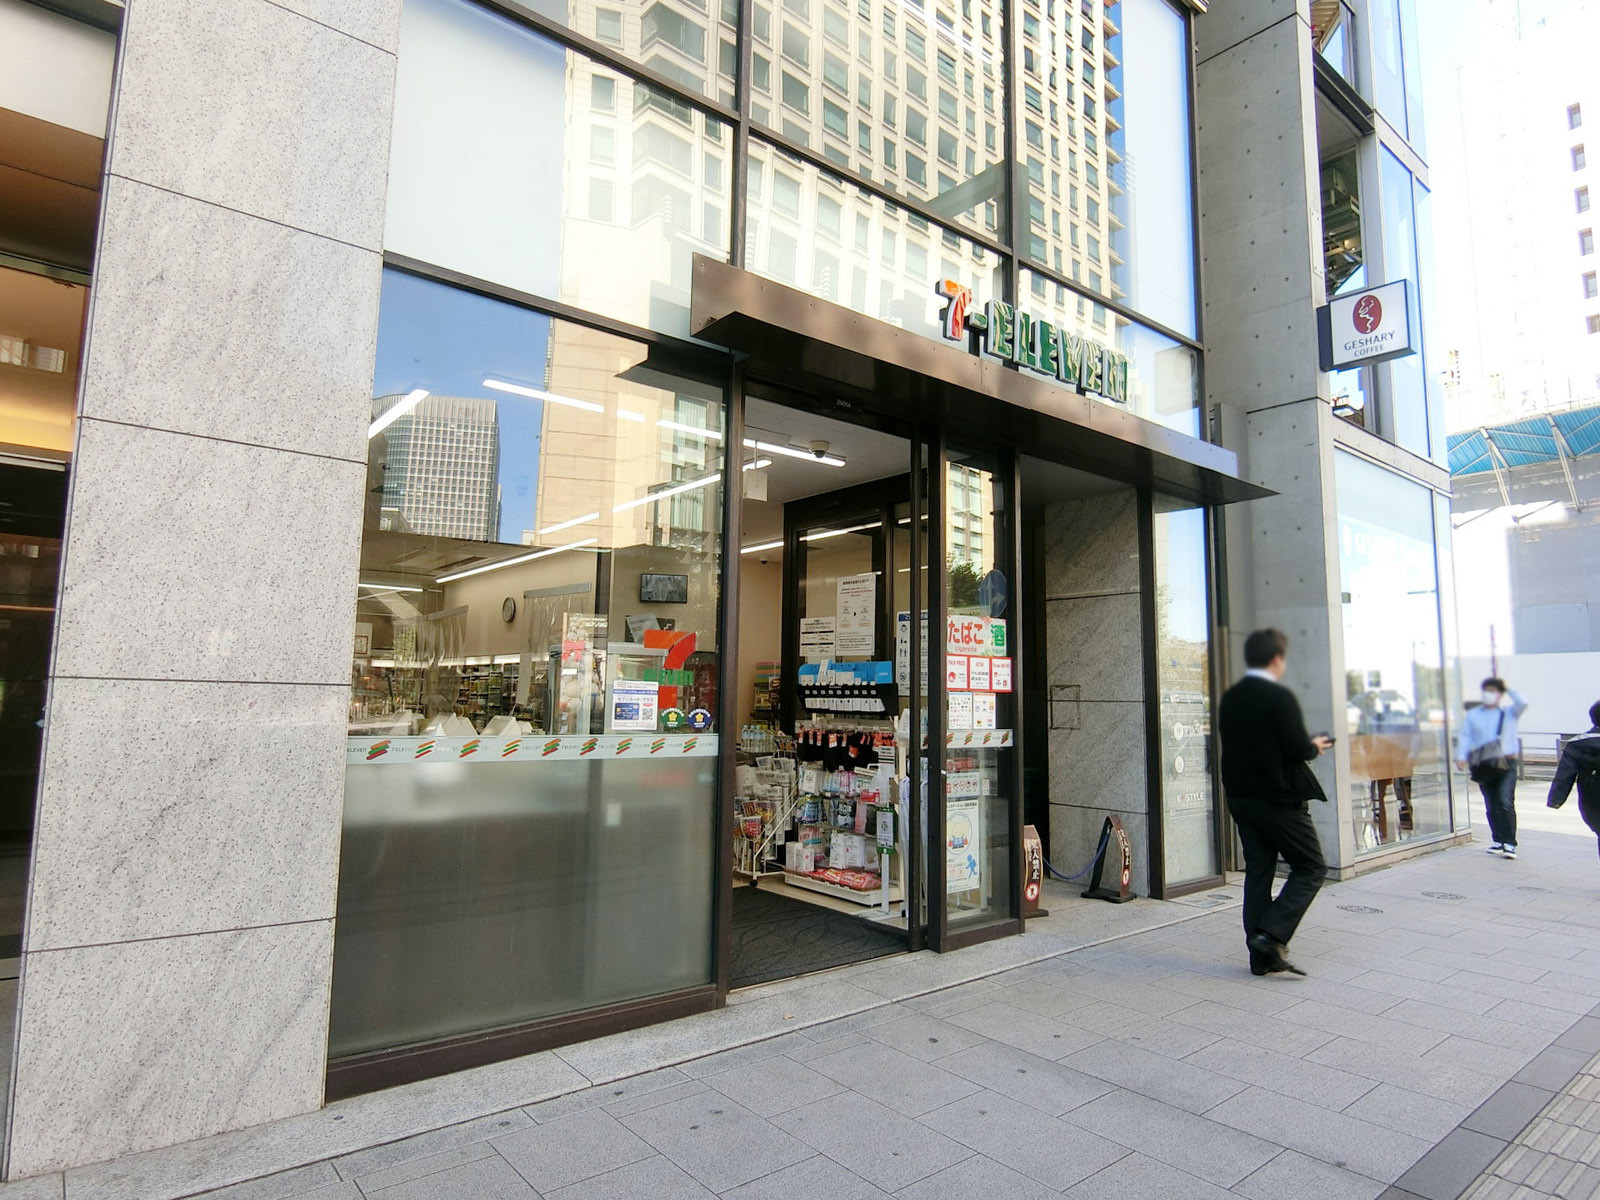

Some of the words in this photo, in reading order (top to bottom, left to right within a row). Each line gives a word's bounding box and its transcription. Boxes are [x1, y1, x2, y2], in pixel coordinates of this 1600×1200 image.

[1344, 331, 1396, 351] GESHARY
[1354, 345, 1384, 357] COFFEE
[948, 620, 984, 645] たばこ
[990, 623, 1005, 647] 酒
